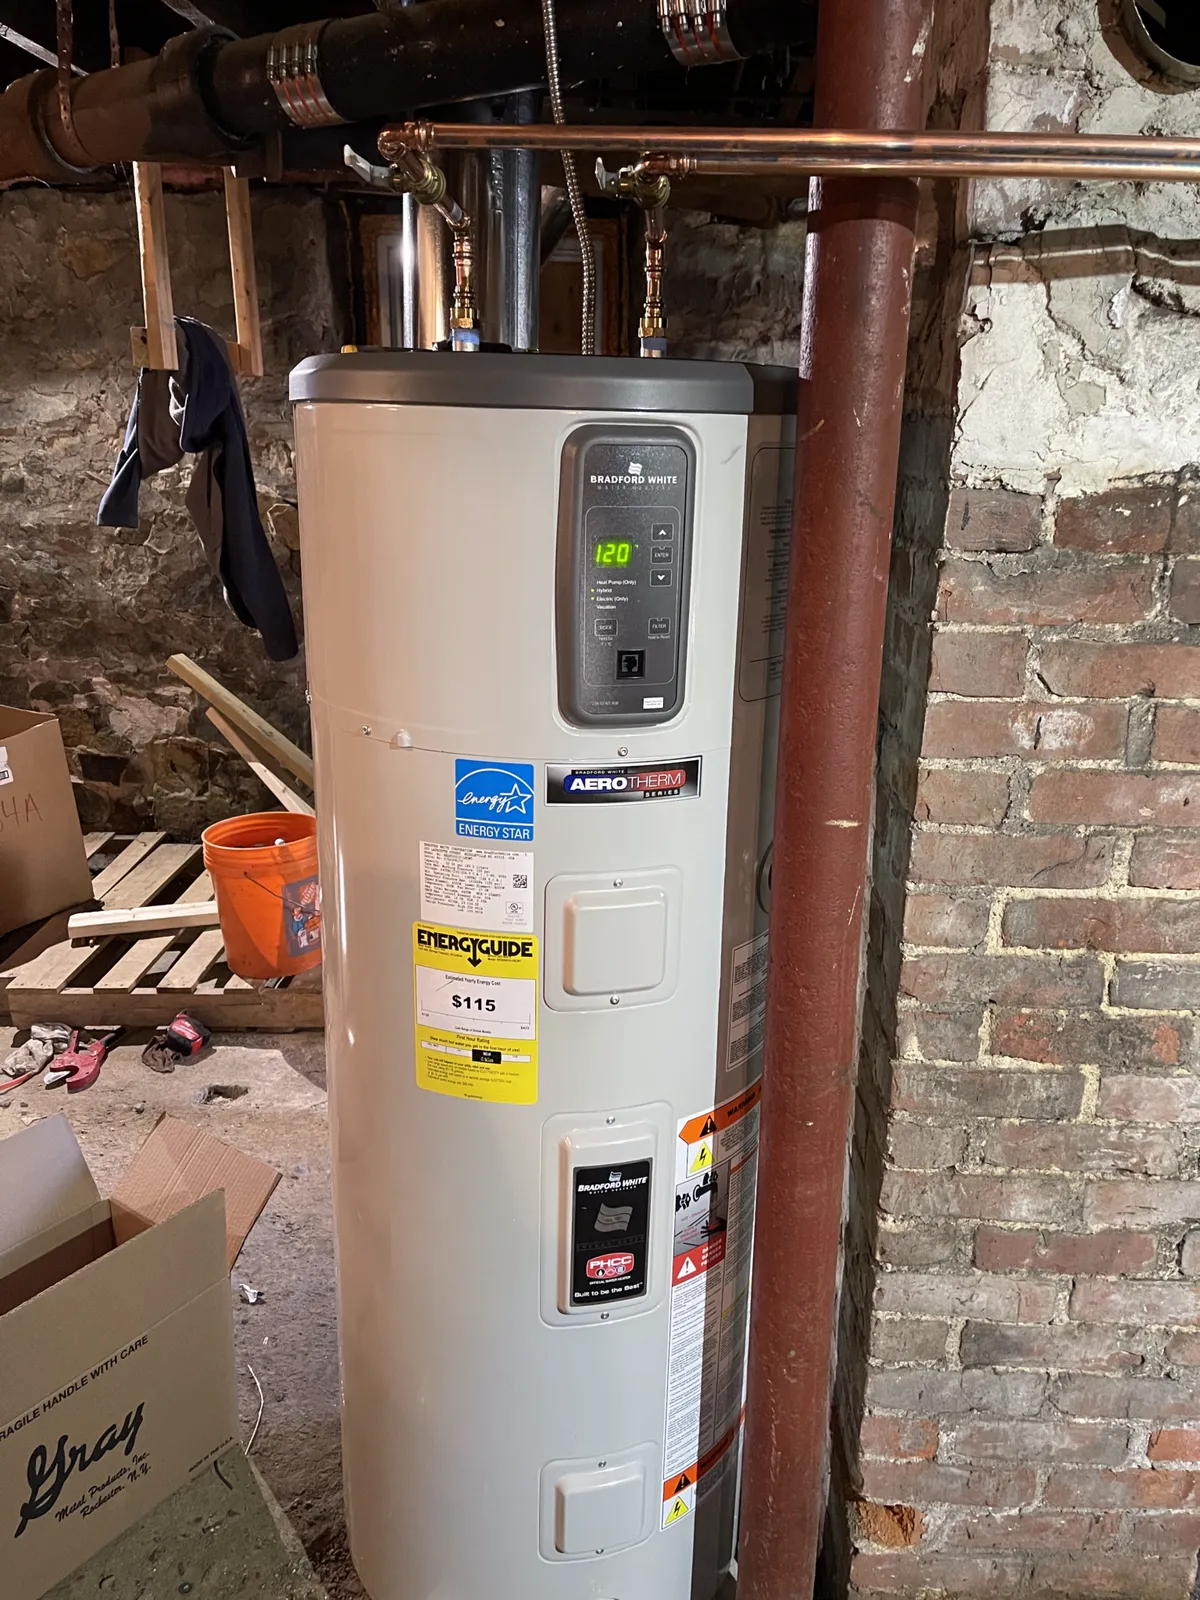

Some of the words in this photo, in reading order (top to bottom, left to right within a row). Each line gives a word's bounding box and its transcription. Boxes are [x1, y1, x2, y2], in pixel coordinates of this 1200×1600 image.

[590, 475, 645, 484] BRADFORD
[648, 475, 678, 484] WHITE
[595, 543, 630, 563] 120
[569, 772, 683, 791] AEROTHERM
[457, 789, 508, 813] energy
[645, 789, 680, 798] SERIES
[458, 822, 500, 838] ENERGY
[502, 826, 530, 840] STAR
[417, 928, 533, 958] ENERGYGUIDE
[445, 974, 464, 983] Estimated
[476, 979, 491, 987] Energy
[451, 994, 496, 1012] $115
[727, 1091, 755, 1118] WARNING
[577, 1181, 622, 1192] BRADFORD
[622, 1176, 648, 1187] WHITE
[589, 1255, 632, 1270] PHCC
[43, 1375, 89, 1413] HANDLE
[90, 1355, 118, 1380] WITH
[120, 1335, 149, 1360] CARE
[14, 1401, 146, 1539] Gray
[127, 1465, 152, 1483] N.Y.
[55, 1495, 86, 1522] Metal
[132, 1452, 150, 1467] Inc.
